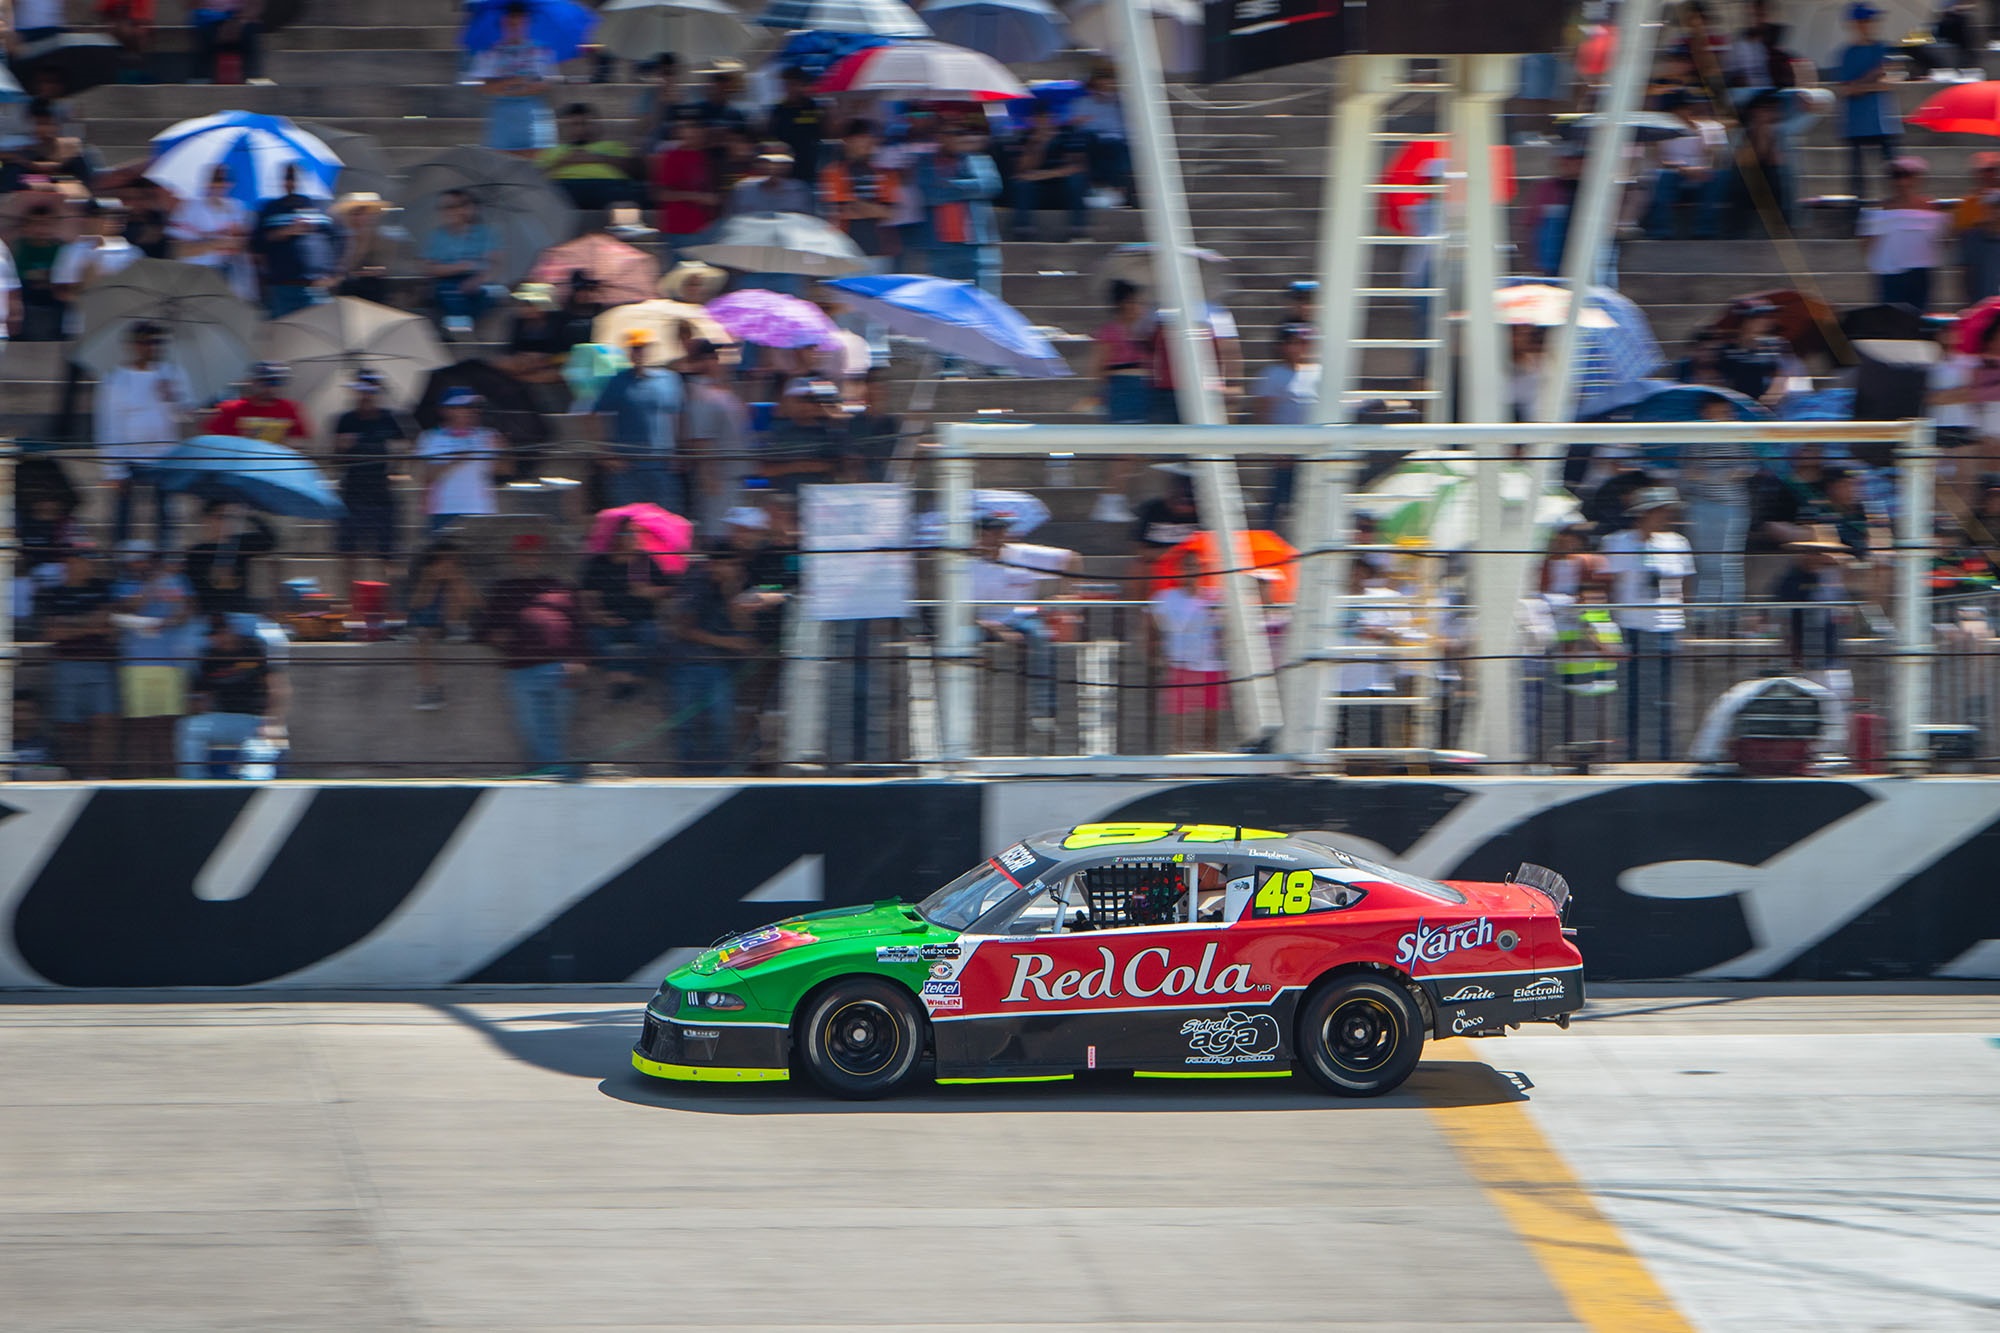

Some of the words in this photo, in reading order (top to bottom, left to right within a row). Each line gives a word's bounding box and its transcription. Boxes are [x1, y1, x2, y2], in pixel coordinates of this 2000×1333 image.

[1172, 853, 1184, 863] 48
[1255, 869, 1313, 915] 48
[1001, 946, 1122, 1002] Red
[1123, 942, 1256, 998] Cola
[1257, 984, 1271, 992] MR
[925, 983, 958, 993] telcel
[1442, 985, 1496, 1001] Linde
[1513, 983, 1565, 998] Electrolit
[926, 998, 961, 1006] WHELEN
[1456, 1008, 1466, 1017] MI
[1180, 1018, 1230, 1034] Sidral
[1452, 1016, 1484, 1034] Choco
[1189, 1028, 1258, 1056] aga
[1185, 1056, 1235, 1065] racing
[1235, 1055, 1275, 1063] team
